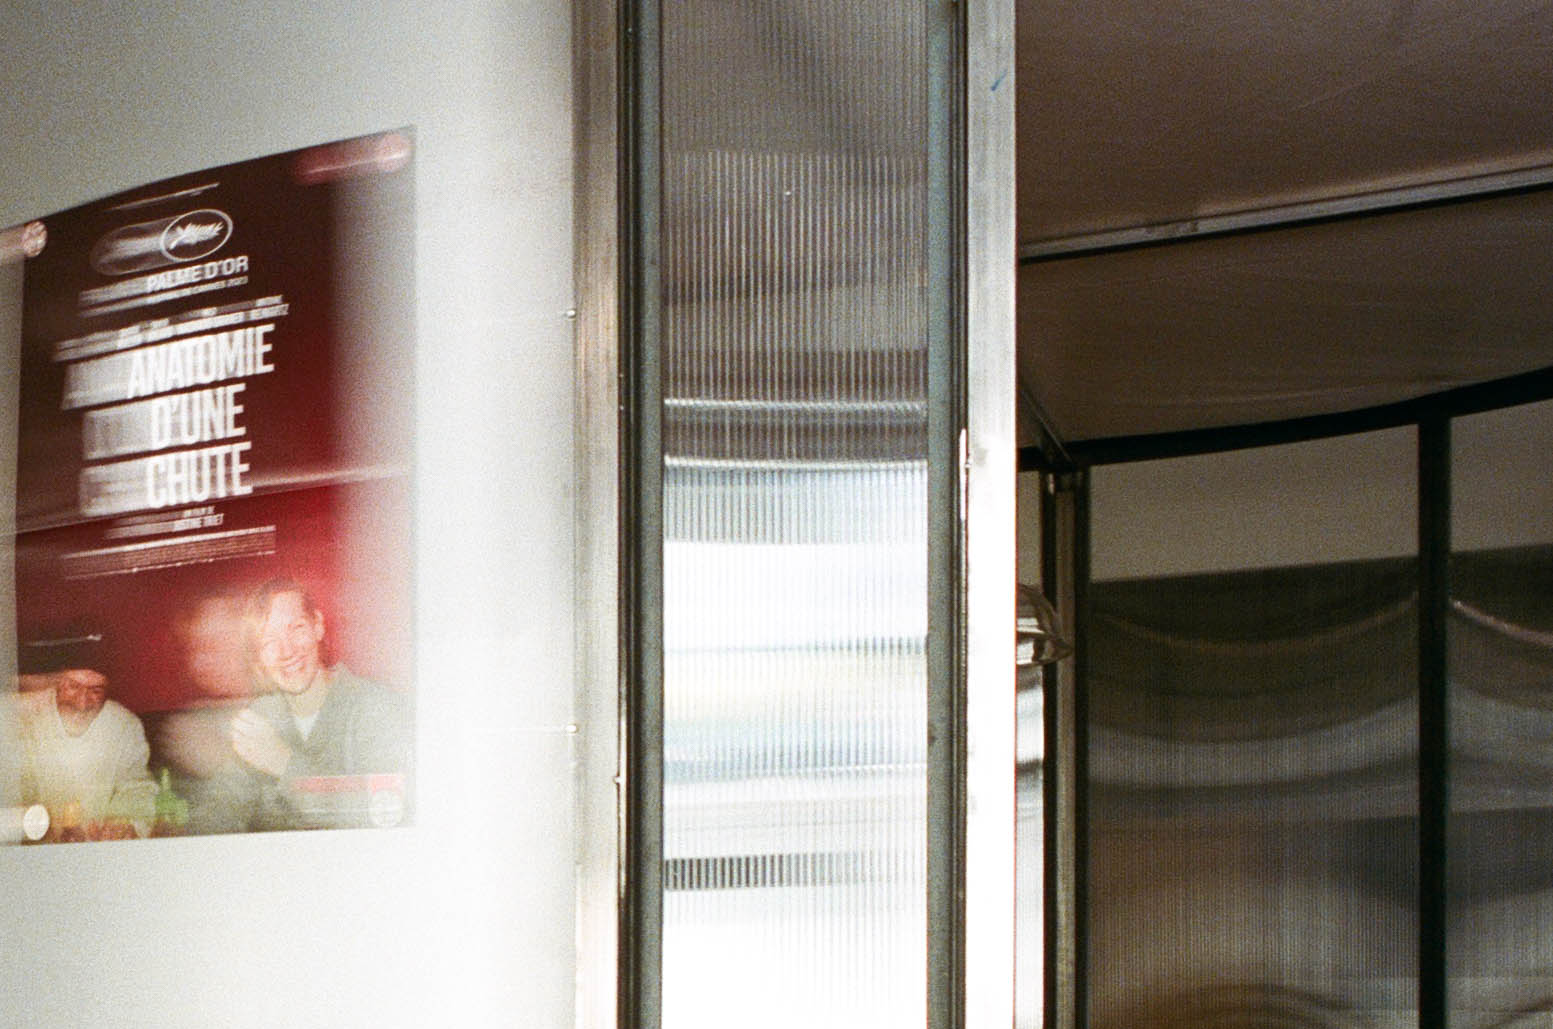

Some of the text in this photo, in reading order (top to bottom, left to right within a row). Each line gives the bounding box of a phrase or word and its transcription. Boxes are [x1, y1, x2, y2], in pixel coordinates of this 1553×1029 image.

[205, 255, 250, 281] D'OR
[126, 323, 276, 400] ANATOMIE
[150, 383, 247, 451] D'UNE
[145, 441, 254, 509] CHUTE
